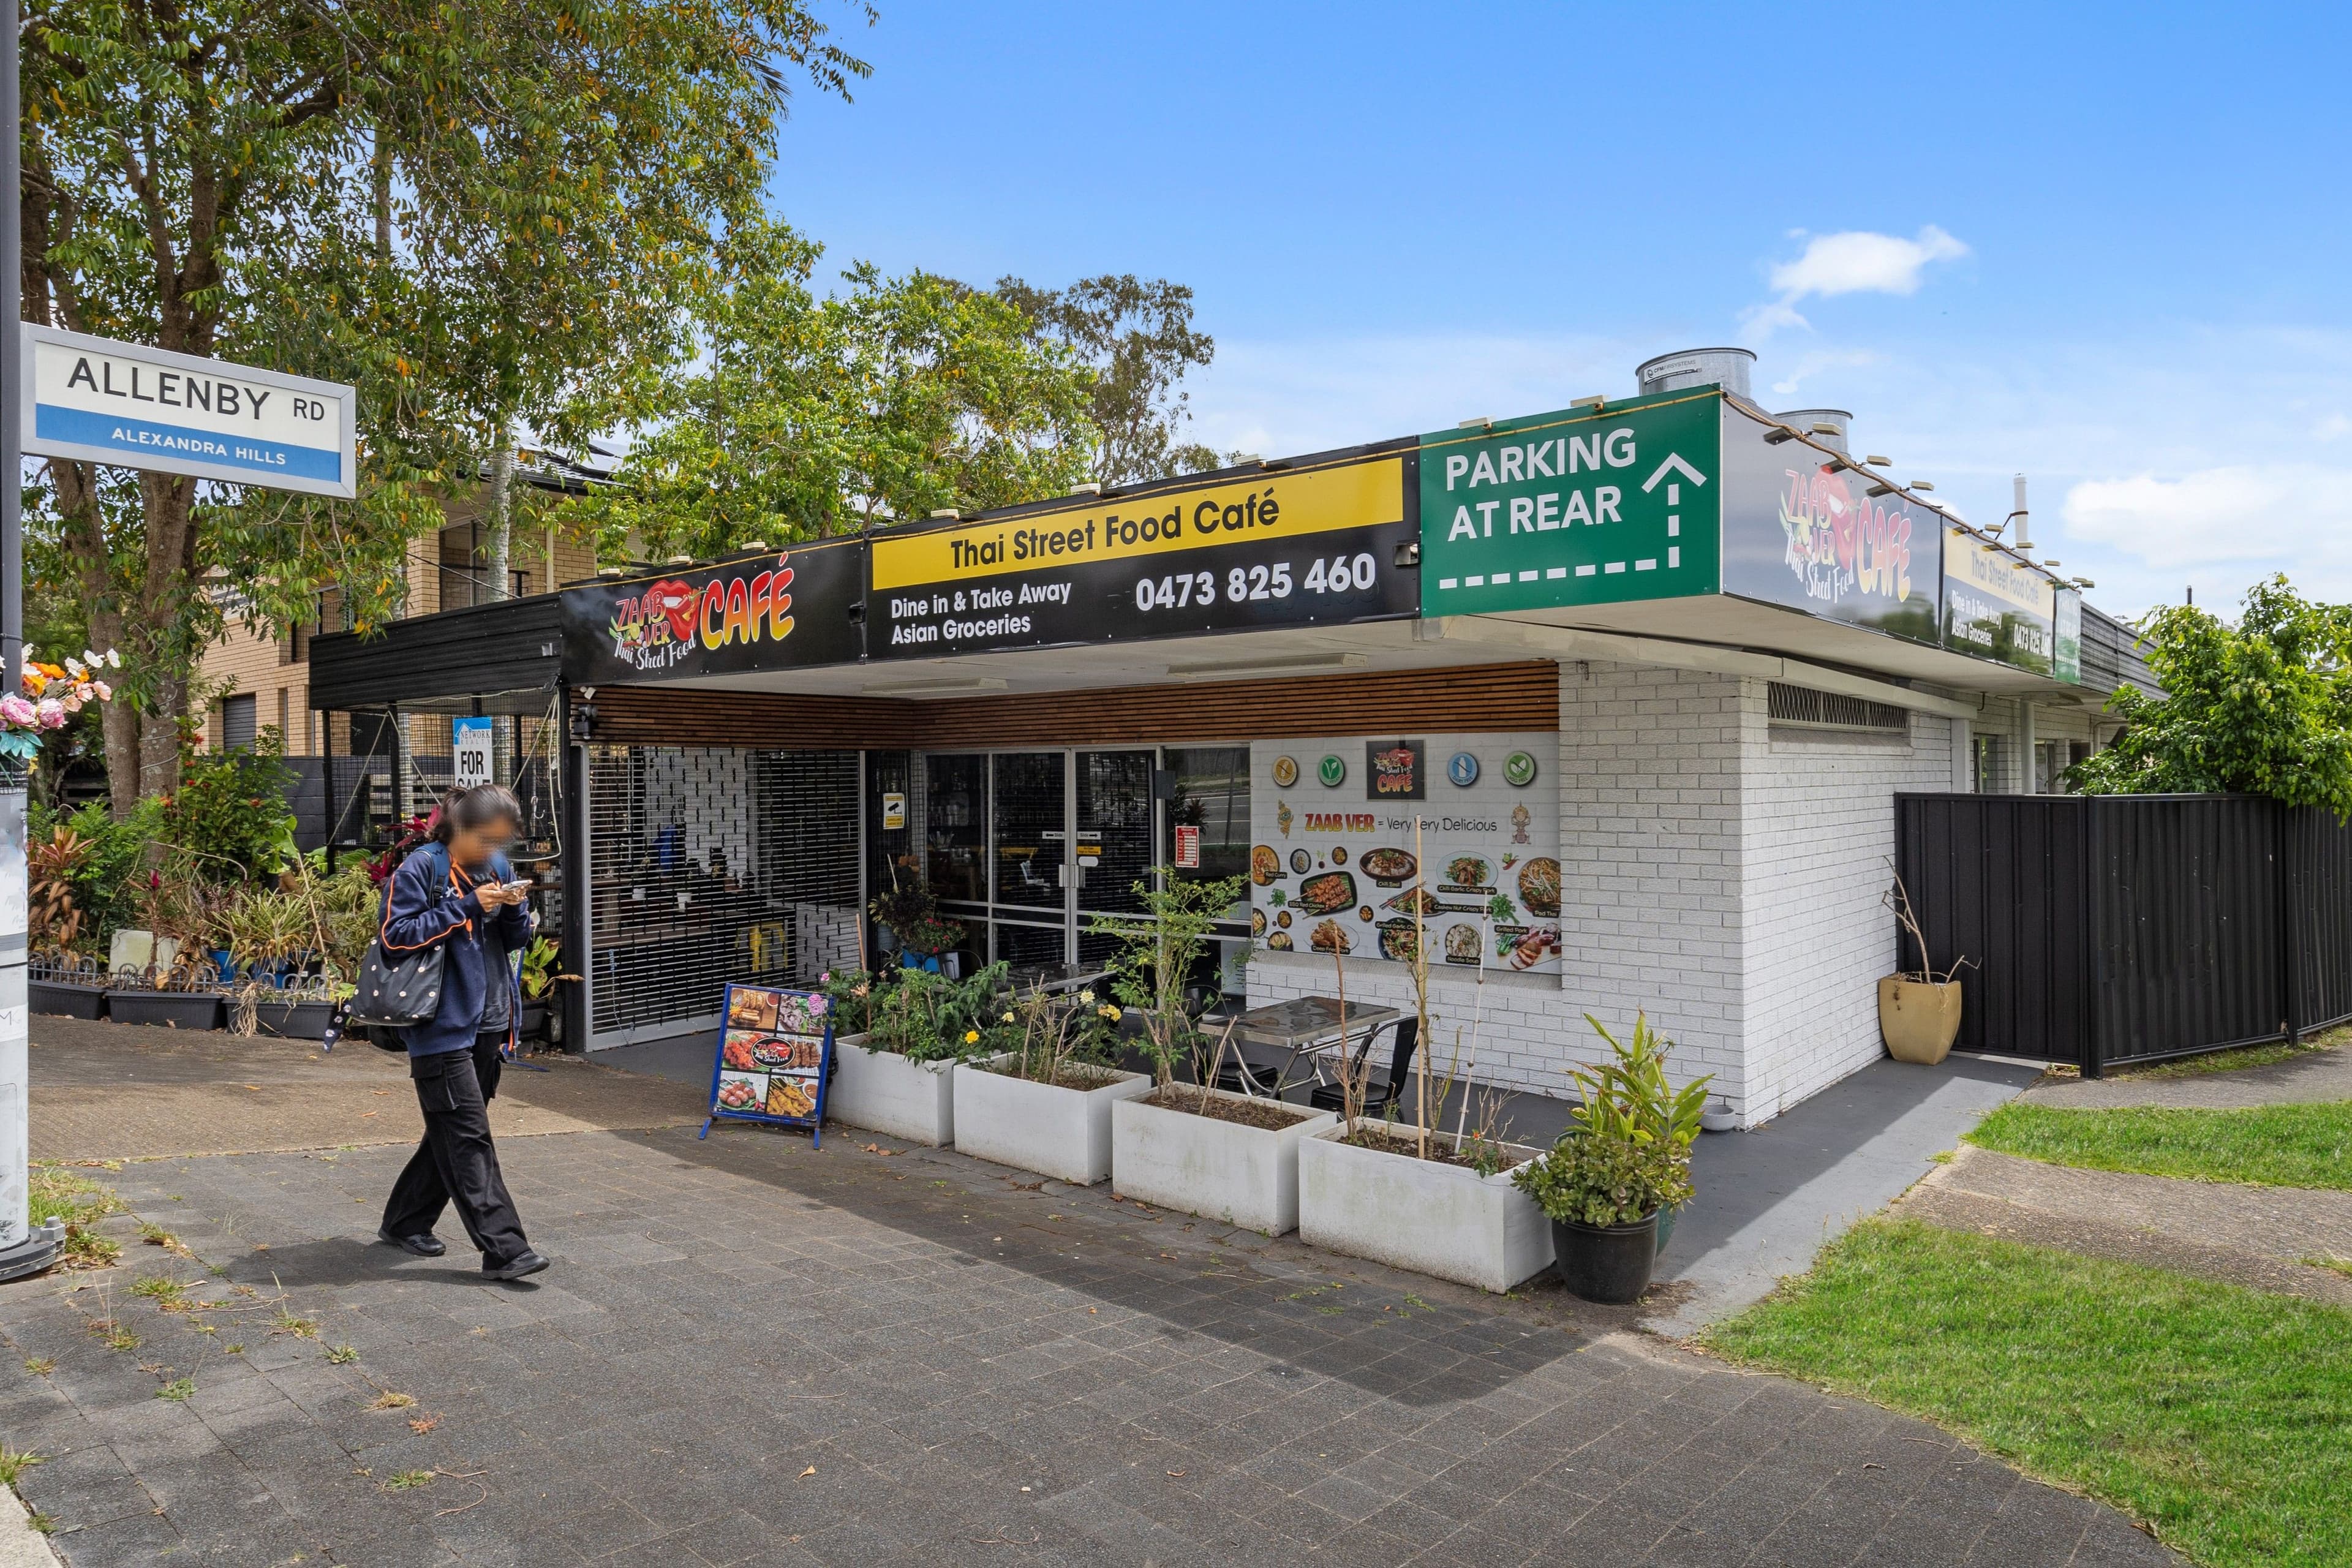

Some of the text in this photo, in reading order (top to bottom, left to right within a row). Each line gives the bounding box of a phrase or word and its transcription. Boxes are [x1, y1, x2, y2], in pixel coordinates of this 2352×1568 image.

[67, 357, 325, 421] ALLENBY RD
[111, 428, 286, 465] ALEXANDRA HILLS
[1446, 428, 1636, 492] PARKING
[1447, 485, 1623, 542] AT REAR
[1785, 469, 1833, 529] ZAAB
[951, 487, 1280, 568] Thai Street Food Café
[1813, 527, 1836, 566] VER
[1785, 527, 1855, 603] Thai Street Food
[1856, 497, 1912, 603] CAFÉ
[1136, 552, 1376, 611] 0473 825 460
[1972, 551, 1987, 580] Thai
[1989, 559, 2008, 591] Street
[2010, 570, 2024, 597] Food
[616, 590, 666, 631] ZAAB
[700, 551, 795, 650] CAFÉ
[891, 583, 1072, 619] Dine in & Take Away
[1951, 589, 2003, 630] Dine in & Take Away
[644, 620, 671, 647] VER
[891, 613, 1031, 645] Asian Groceries
[1951, 616, 1992, 647] Asian Groceries
[2014, 623, 2028, 650] 0473
[2030, 629, 2040, 655] 825
[614, 630, 696, 670] Thai Street Food
[461, 729, 490, 739] NETWORK
[461, 750, 484, 775] FOR
[1377, 769, 1413, 793] CAFÉ
[1305, 813, 1343, 832] ZAAB
[1345, 813, 1375, 832] VER
[1387, 816, 1411, 833] Very
[1442, 817, 1498, 831] Delicious
